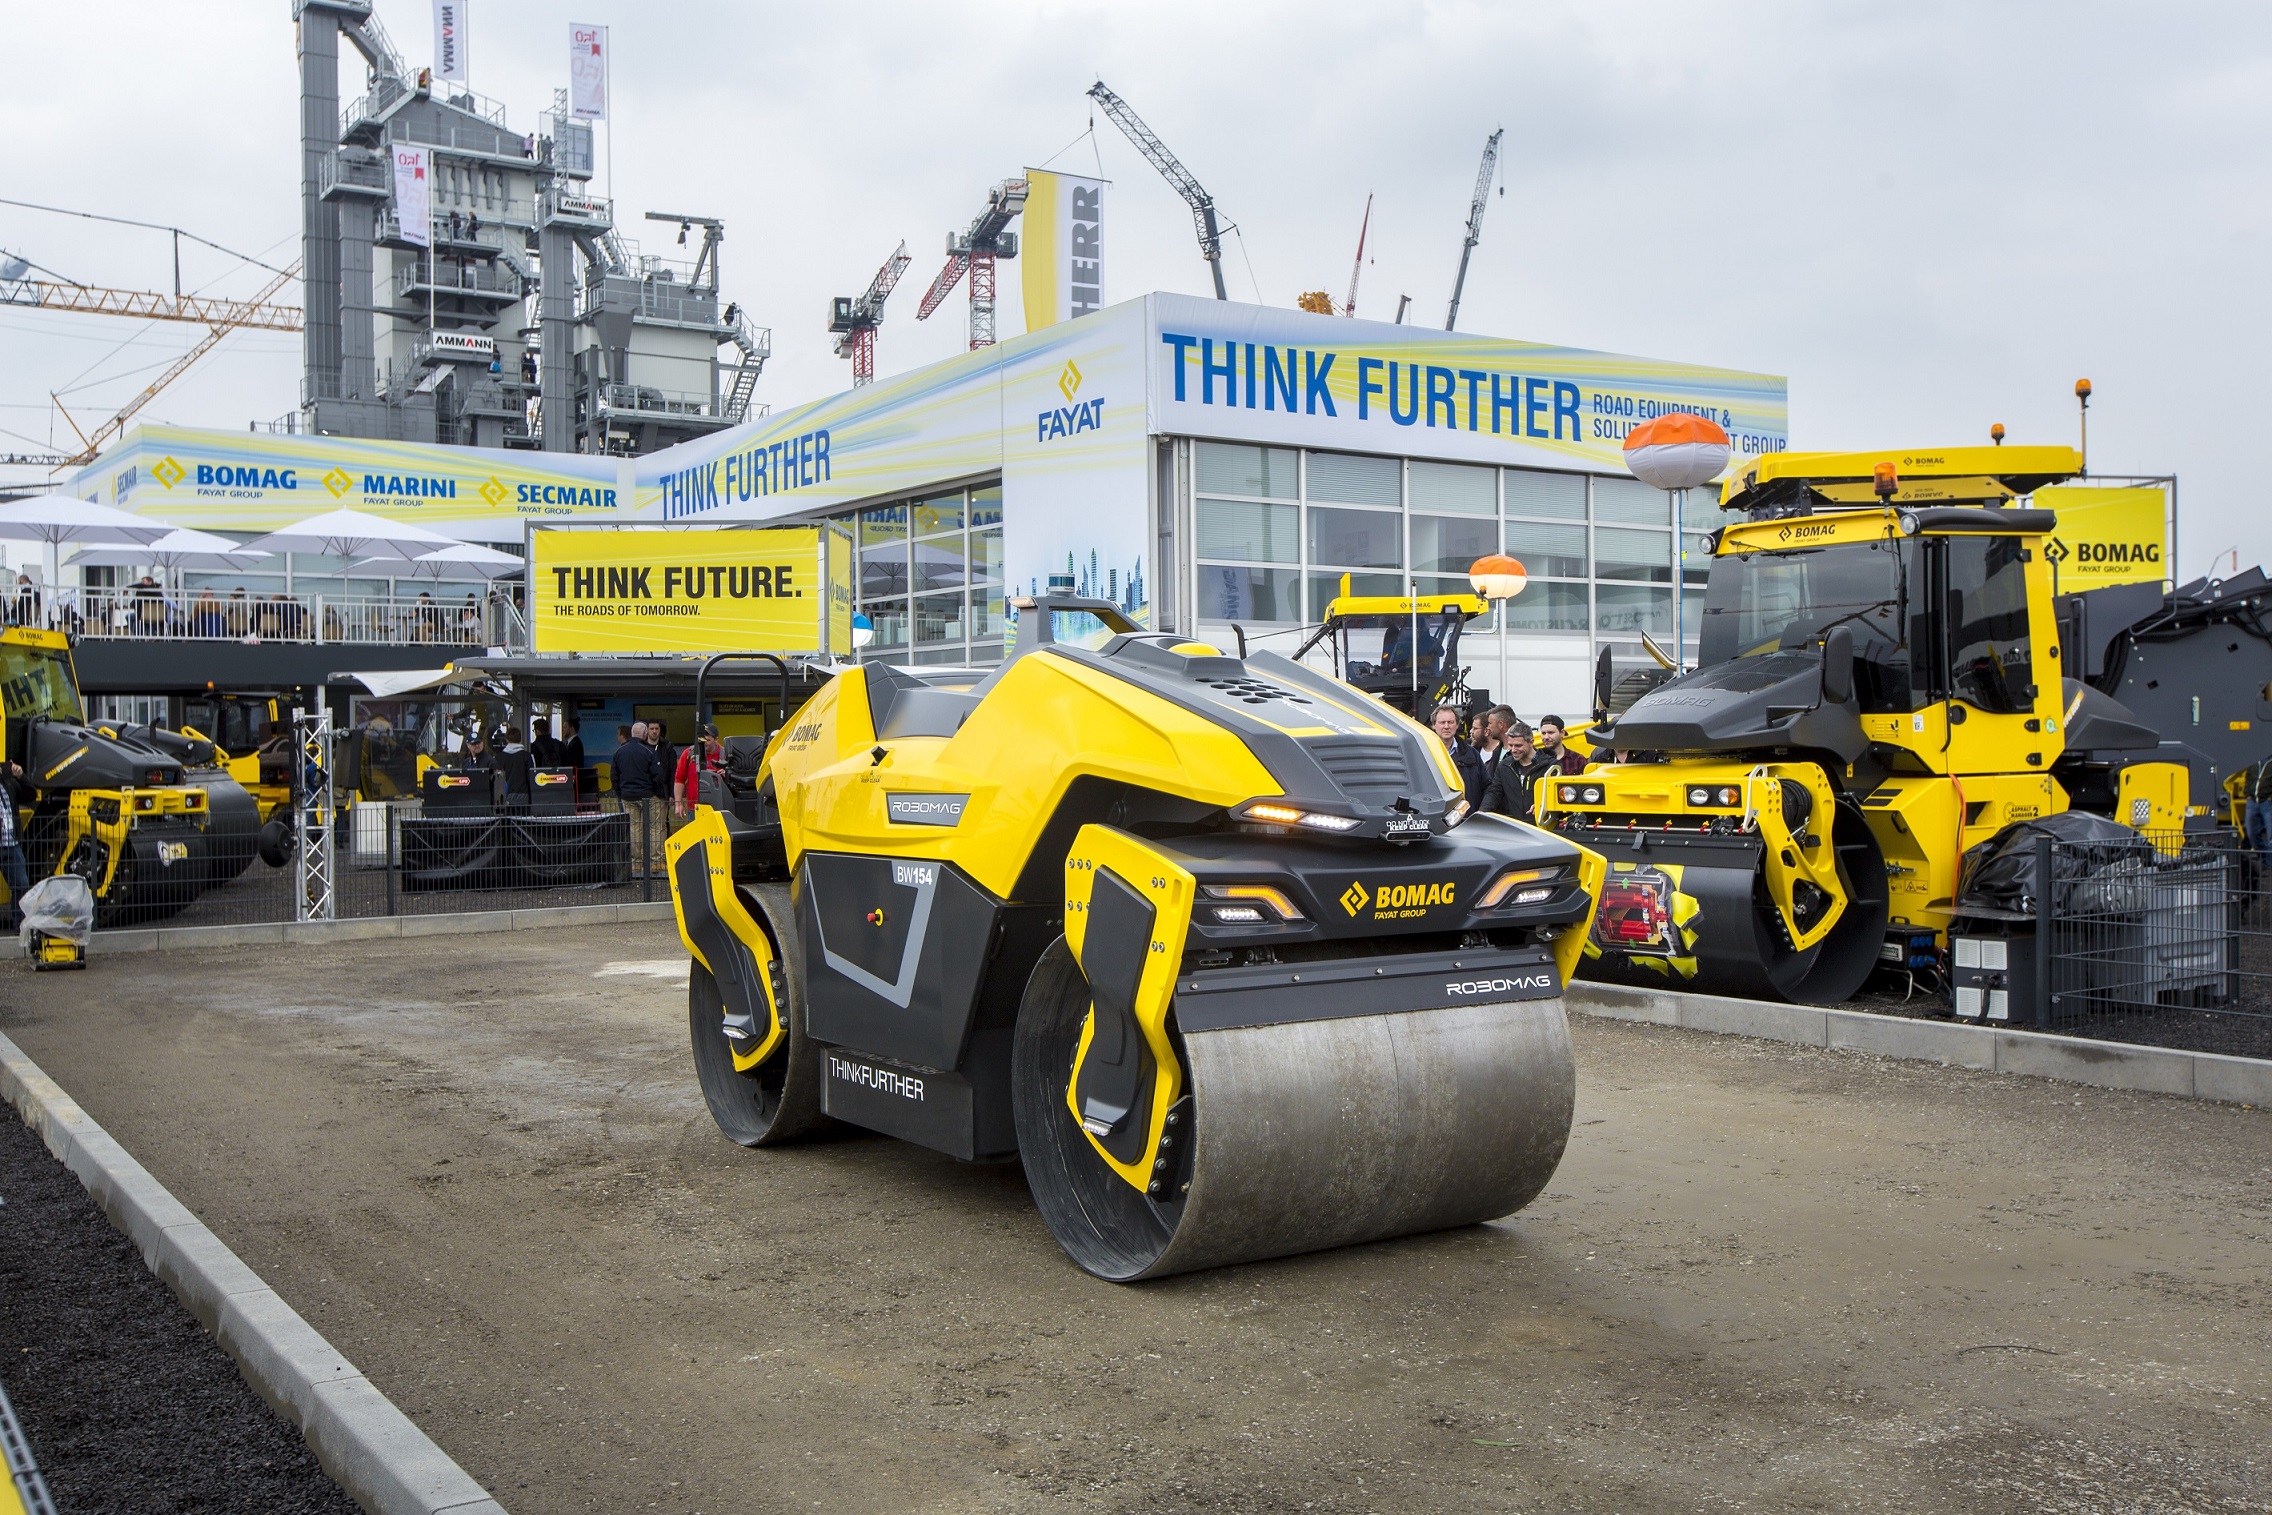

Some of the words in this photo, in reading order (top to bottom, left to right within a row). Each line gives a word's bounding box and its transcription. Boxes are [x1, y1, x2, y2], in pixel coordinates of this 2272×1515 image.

[564, 200, 604, 212] AMMANN
[435, 336, 491, 349] AMMANN
[1162, 333, 1337, 417] THINK
[1358, 357, 1581, 442] FURTHER
[1038, 398, 1104, 442] FAYAT
[1594, 394, 1633, 417] ROAD
[1722, 410, 1731, 427] &
[1742, 435, 1786, 454] GROUP
[117, 465, 137, 496] SECMAIR
[197, 465, 297, 489] BOMAG
[659, 461, 719, 521] THINK
[726, 430, 831, 504] FURTHER
[197, 488, 226, 497] FAYAT
[230, 490, 263, 499] GROUP
[364, 475, 455, 498] MARINI
[517, 484, 617, 507] SECMAIR
[364, 497, 390, 505] FAYAT
[393, 499, 423, 507] GROUP
[517, 506, 541, 514] FAYAT
[545, 507, 572, 515] GROUP
[1795, 525, 1836, 538] BOMAG
[2078, 543, 2159, 562] BOMAG
[552, 566, 652, 599] THINK
[664, 566, 802, 598] FUTURE.
[554, 605, 575, 616] THE
[577, 605, 615, 616] ROADS
[617, 605, 632, 616] OF
[634, 605, 701, 616] TOMORROW.
[1640, 697, 1715, 708] BOMAG
[792, 723, 822, 742] BOMAG
[892, 801, 961, 814] ROBOMAG
[2033, 807, 2039, 817] 2
[897, 866, 932, 885] BW154
[1376, 882, 1455, 909] BOMAG
[1374, 911, 1398, 920] FAYAT
[1400, 909, 1426, 918] GROUP
[1446, 975, 1550, 995] ROBOMAG
[830, 1057, 924, 1101] THINKFURTHER
